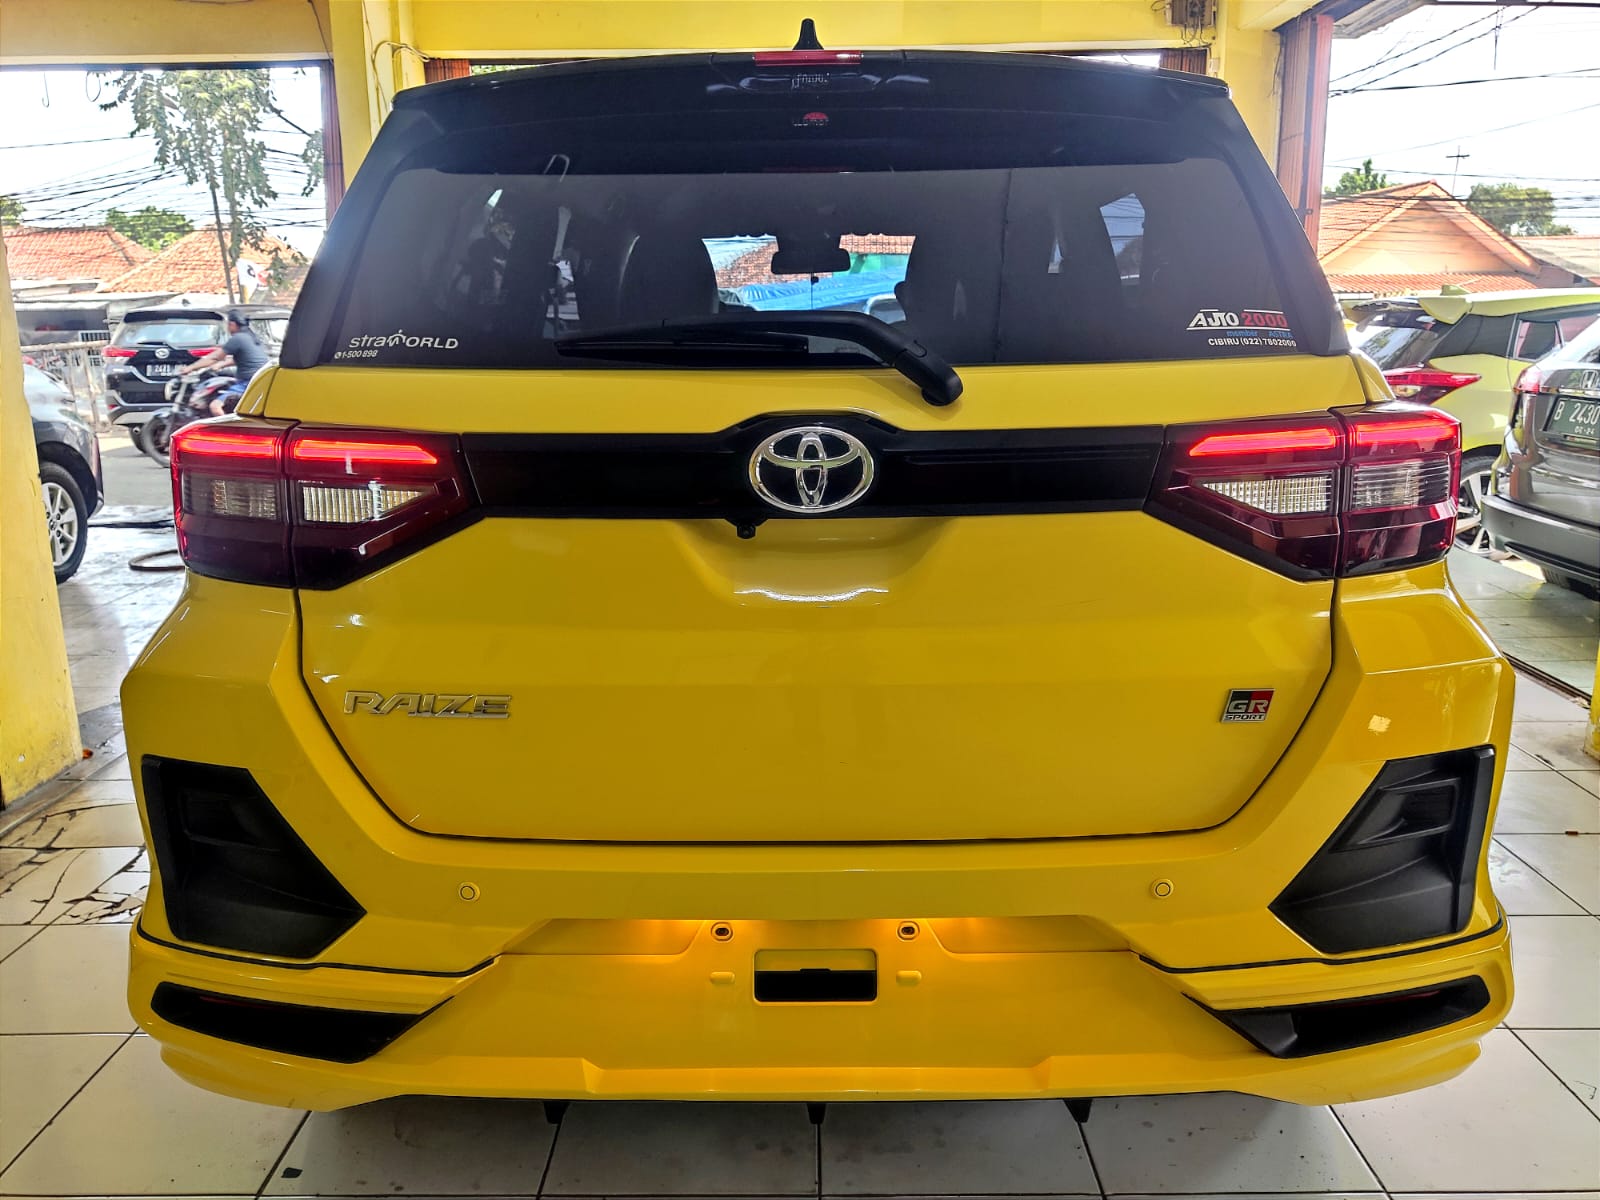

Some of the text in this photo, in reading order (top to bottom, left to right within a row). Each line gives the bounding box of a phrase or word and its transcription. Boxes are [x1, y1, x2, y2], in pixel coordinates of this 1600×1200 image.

[1241, 312, 1289, 328] 2000
[1208, 338, 1240, 346] CIBIRU
[1554, 401, 1600, 425] B 2430
[343, 691, 512, 719] RAIZE
[1228, 699, 1269, 713] GR
